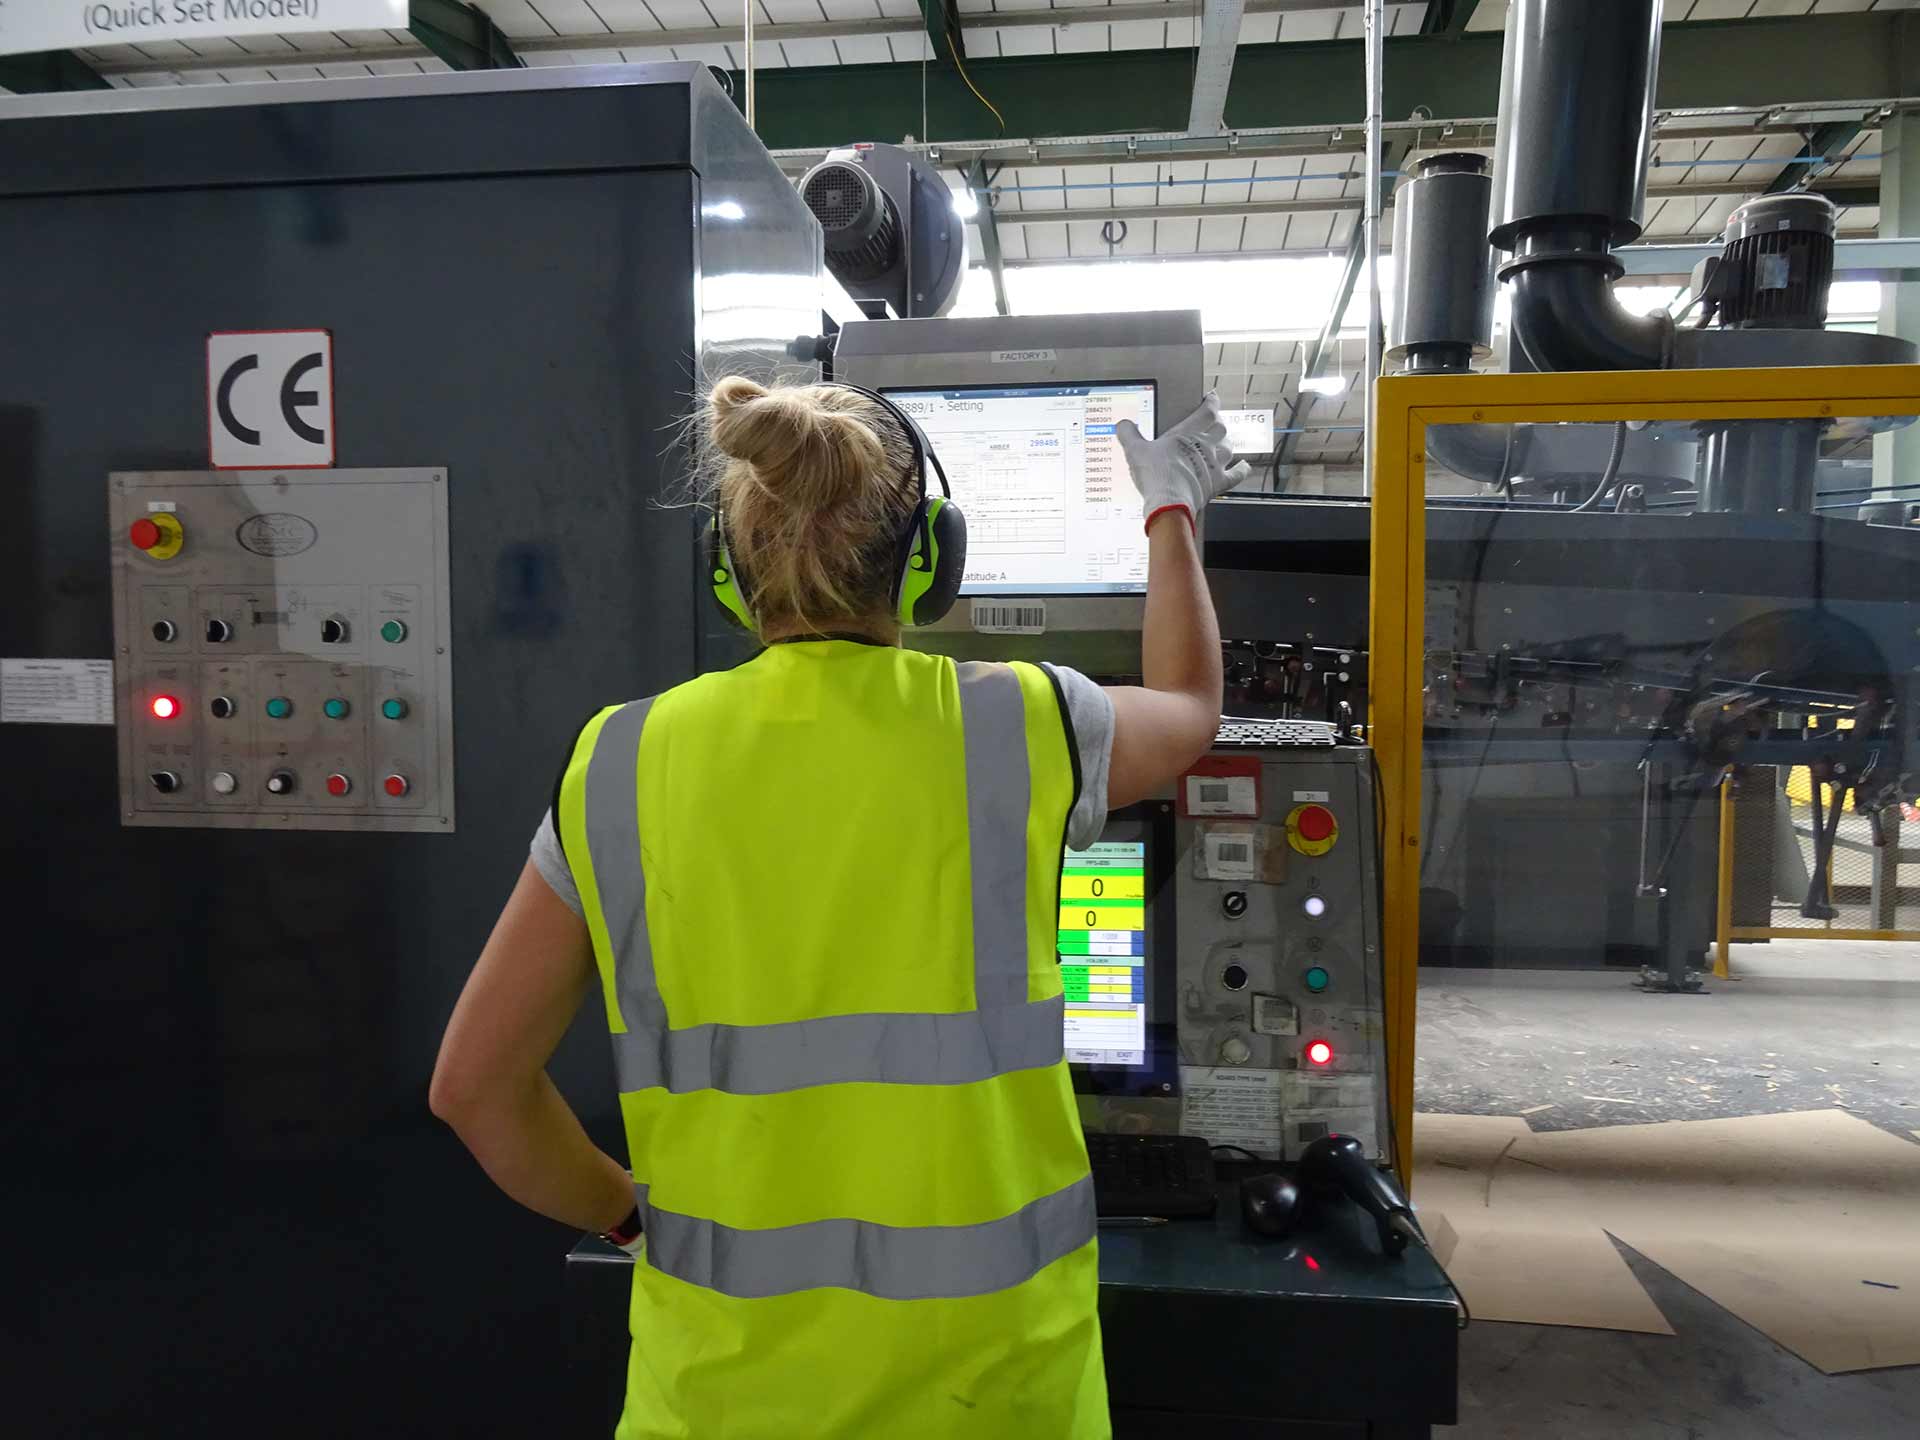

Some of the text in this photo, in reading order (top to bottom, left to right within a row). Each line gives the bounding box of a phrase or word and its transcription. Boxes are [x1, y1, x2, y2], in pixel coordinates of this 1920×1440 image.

[83, 0, 318, 34] (Quick Set Model)
[1000, 351, 1048, 361] FACTORY 3
[217, 352, 325, 446] CE
[947, 400, 984, 413] Setting
[1000, 571, 1007, 581] A
[1091, 878, 1104, 897] 0
[1085, 910, 1097, 927] 0
